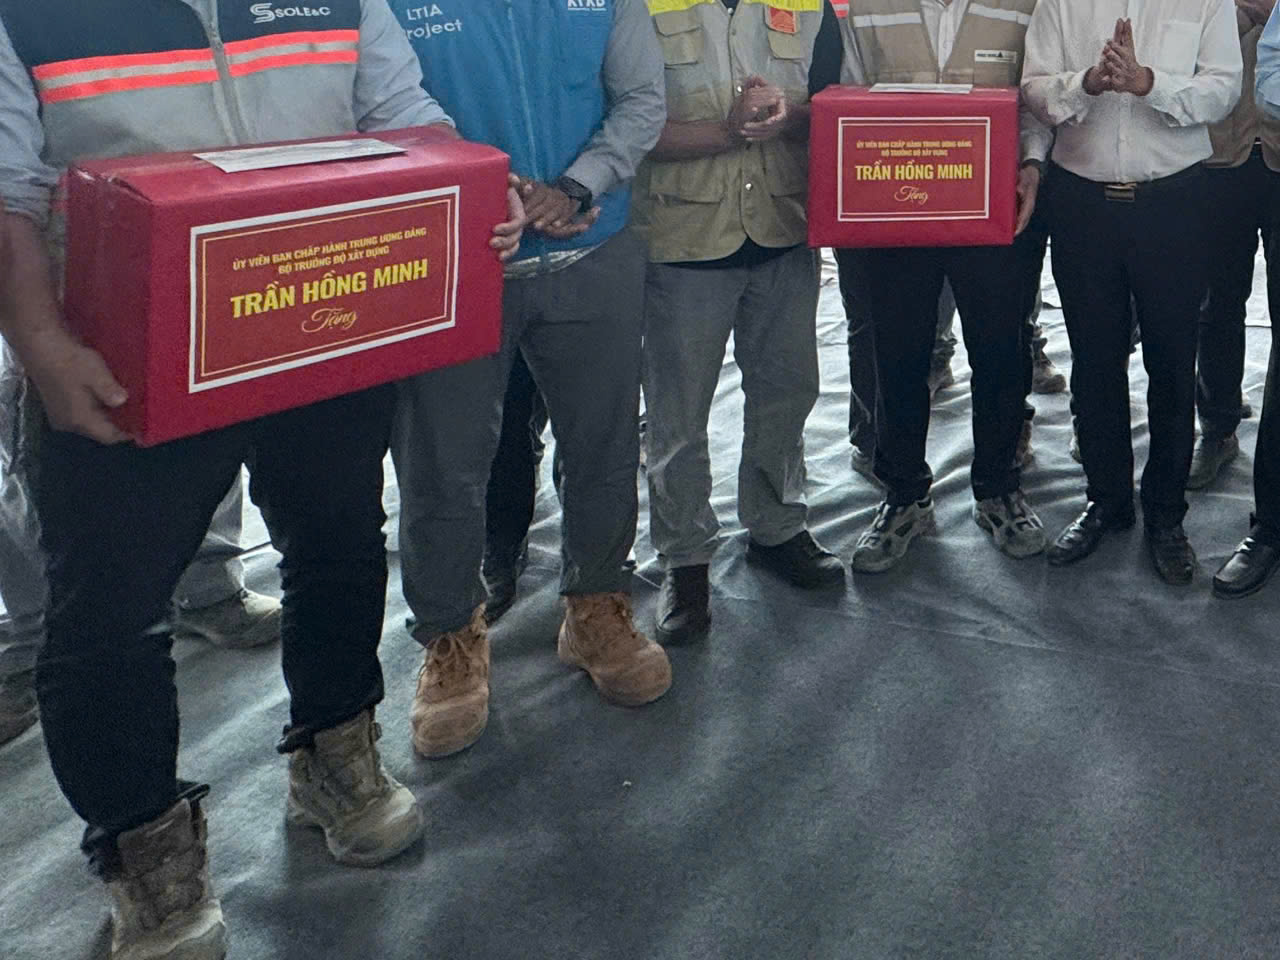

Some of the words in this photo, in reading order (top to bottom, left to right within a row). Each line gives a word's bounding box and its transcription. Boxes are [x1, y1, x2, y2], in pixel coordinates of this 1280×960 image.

[407, 4, 442, 21] LTIA
[407, 19, 463, 40] roject
[855, 160, 891, 180] TRẦN
[895, 159, 934, 180] HỒNG
[937, 164, 973, 179] MINH
[230, 279, 295, 319] TRẦN
[303, 269, 367, 304] HỒNG
[373, 258, 428, 289] MINH
